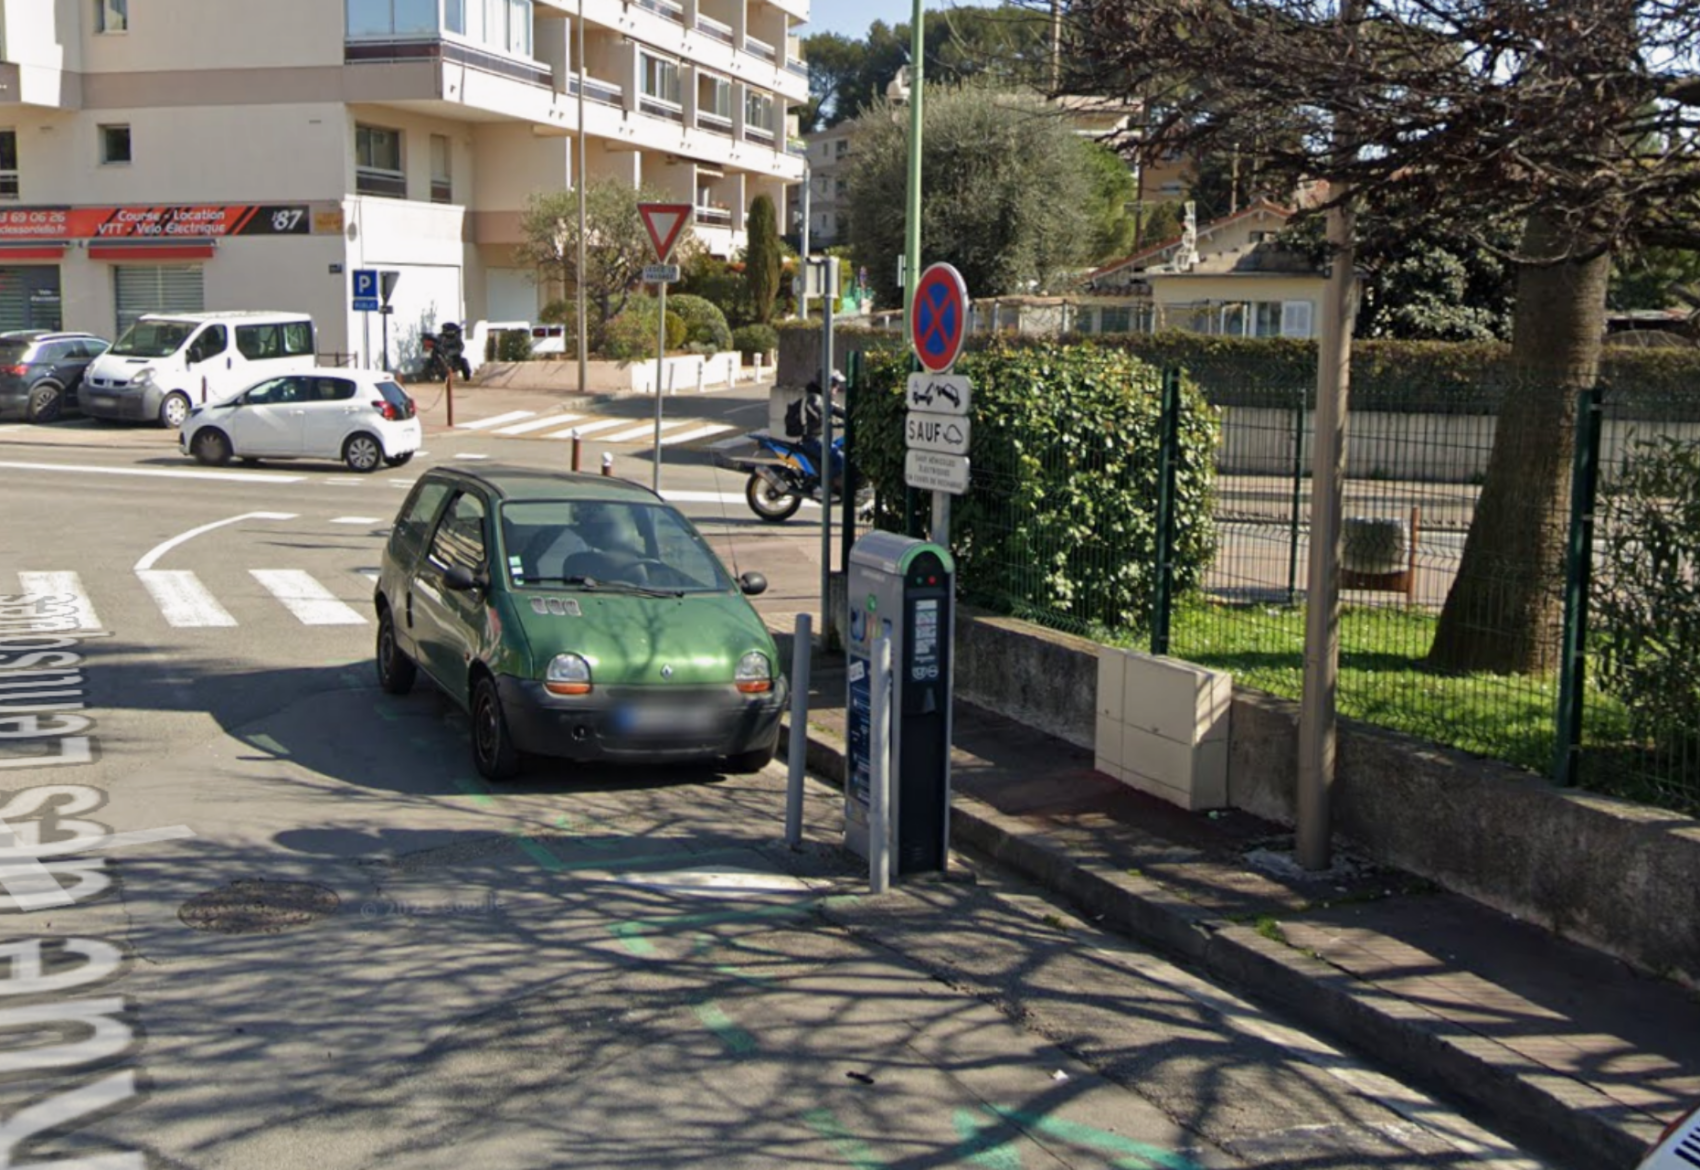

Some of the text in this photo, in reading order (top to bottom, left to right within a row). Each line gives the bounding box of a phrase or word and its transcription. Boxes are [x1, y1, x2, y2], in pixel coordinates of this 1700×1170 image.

[10, 211, 27, 223] 69
[29, 211, 47, 223] 06
[49, 211, 66, 222] 26
[118, 210, 160, 222] Course
[173, 208, 225, 220] Location
[98, 222, 124, 235] VTT
[358, 275, 371, 293] P
[908, 420, 941, 443] SAUF
